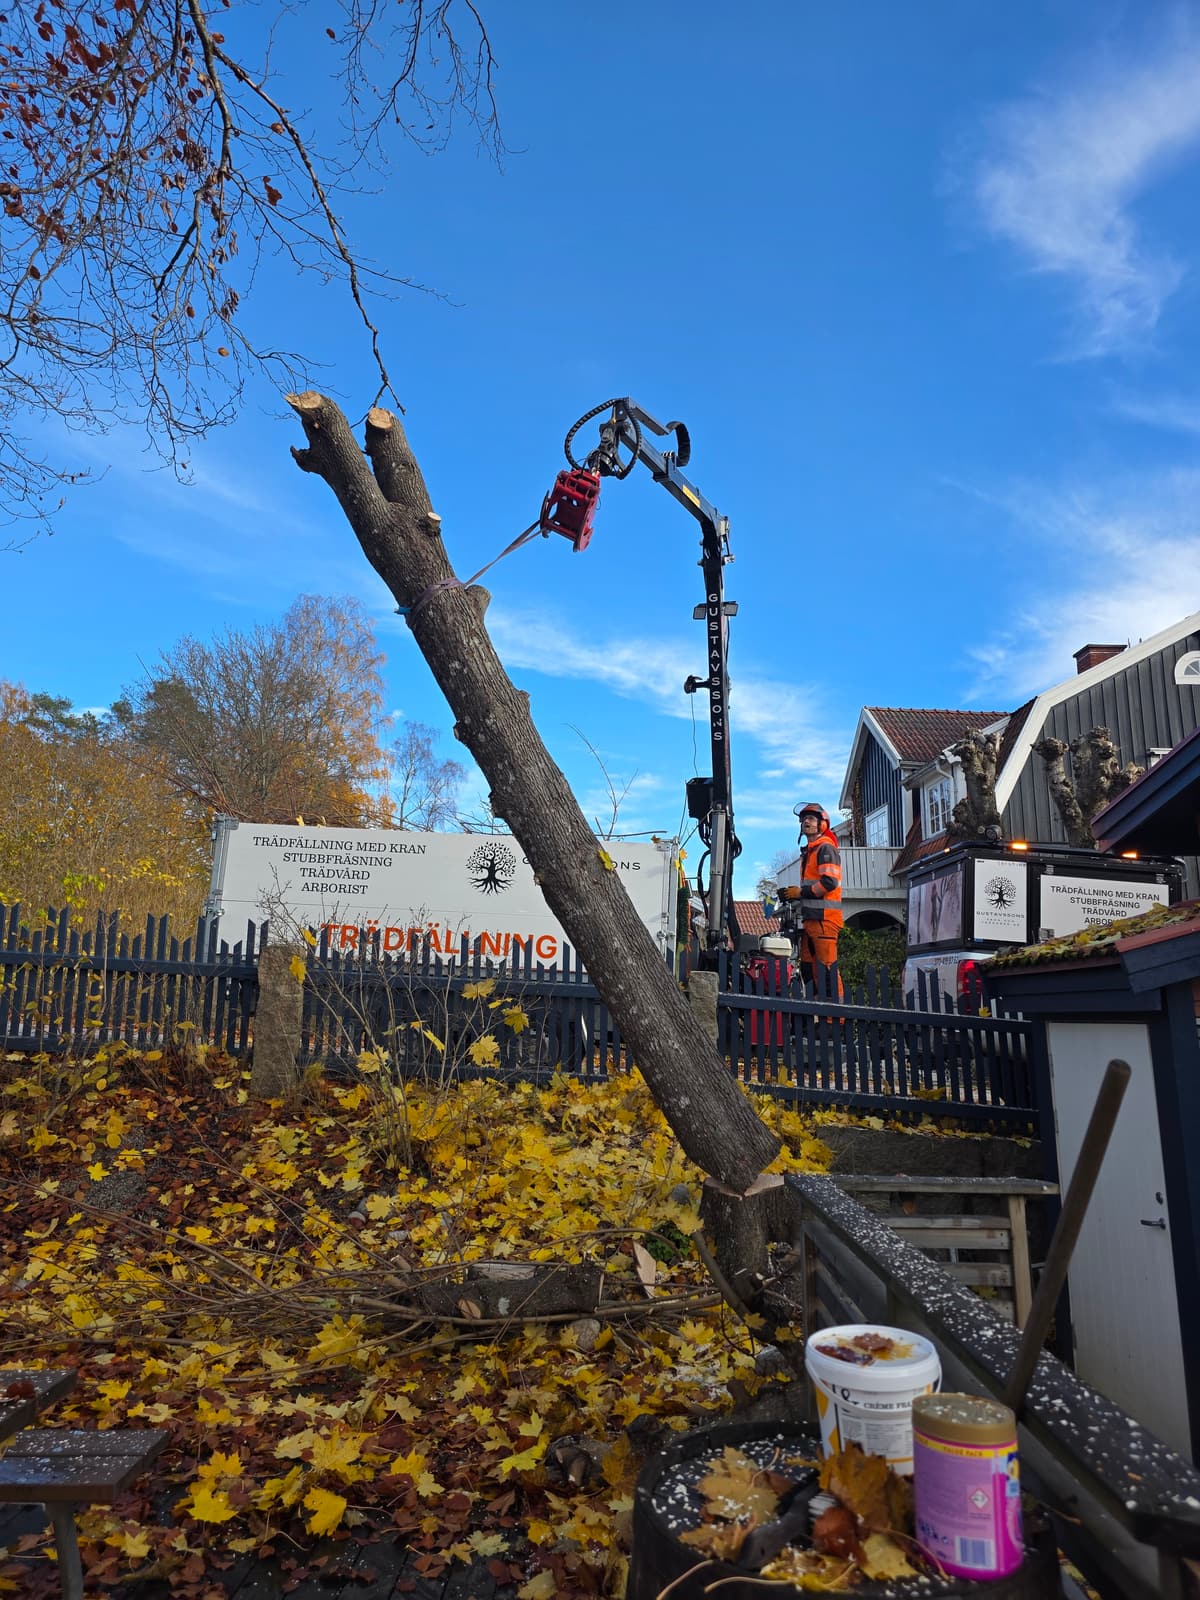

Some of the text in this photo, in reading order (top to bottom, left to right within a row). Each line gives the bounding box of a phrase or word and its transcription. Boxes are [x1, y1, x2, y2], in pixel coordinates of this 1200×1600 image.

[708, 593, 723, 741] GUSTAVSSONS
[253, 835, 426, 855] TRÄDFÄLLNING MED KRAN
[283, 852, 393, 867] STUBBFRÄSNING
[300, 866, 370, 880] TRÄDVÅRD
[301, 882, 368, 895] ARBORIST
[1050, 885, 1160, 901] TRÄDFÄLLNING MED KRAN
[1082, 907, 1127, 918] TRÄDVÅRD
